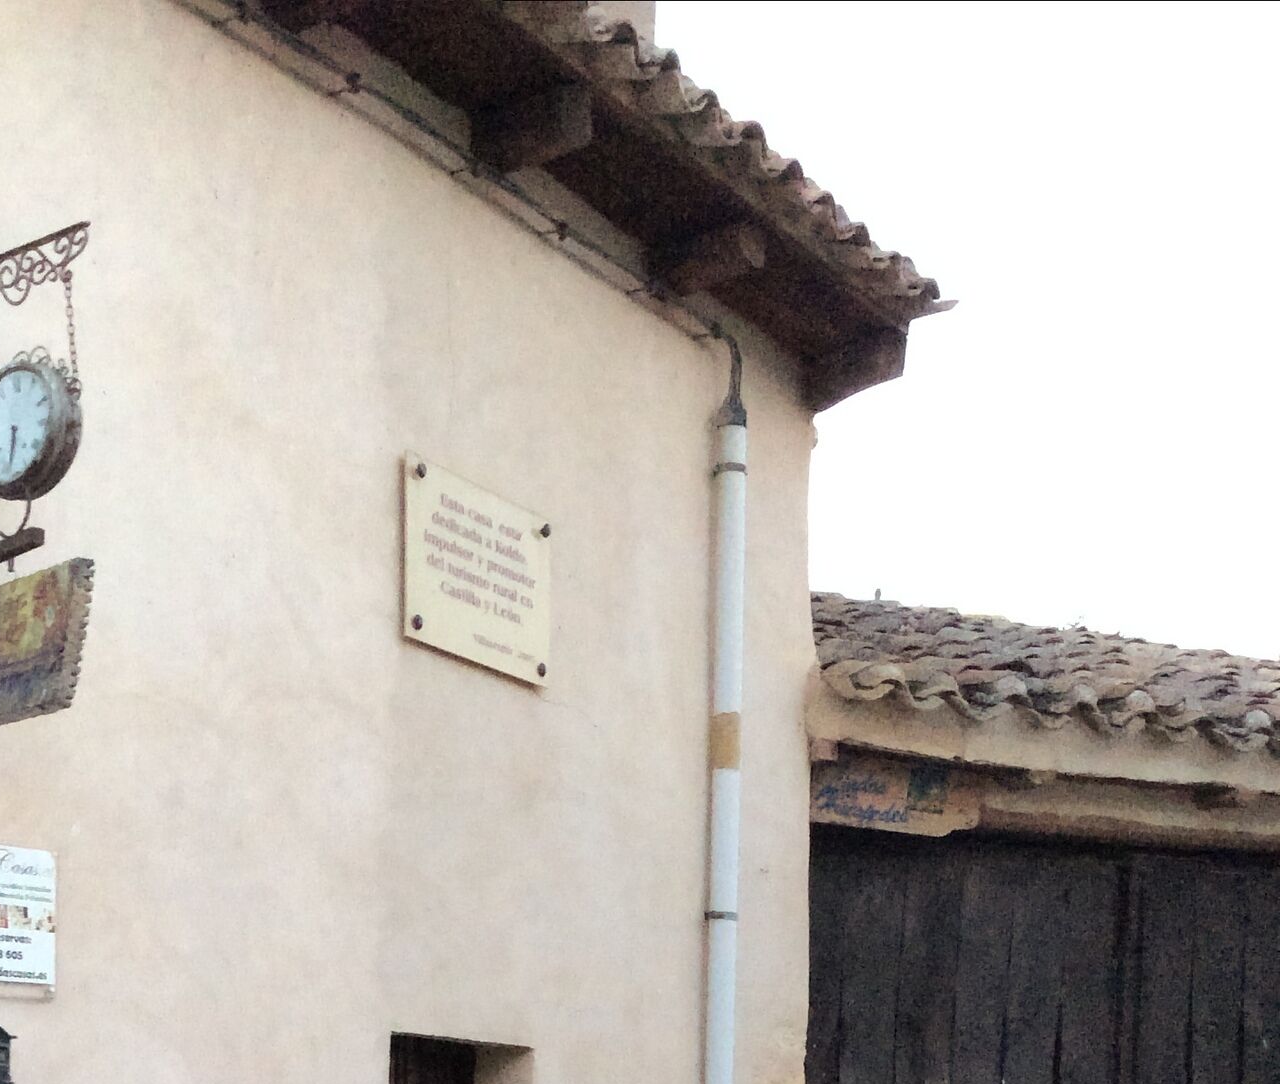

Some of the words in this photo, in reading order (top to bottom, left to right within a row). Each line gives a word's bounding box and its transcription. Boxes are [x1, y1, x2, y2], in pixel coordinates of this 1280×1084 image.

[431, 512, 482, 545] dedicada
[468, 508, 493, 528] casa
[426, 552, 445, 572] del
[448, 562, 491, 590] turismo
[493, 582, 518, 602] rural
[520, 595, 534, 609] en
[487, 559, 537, 590] promotor
[440, 581, 482, 608] Castilla
